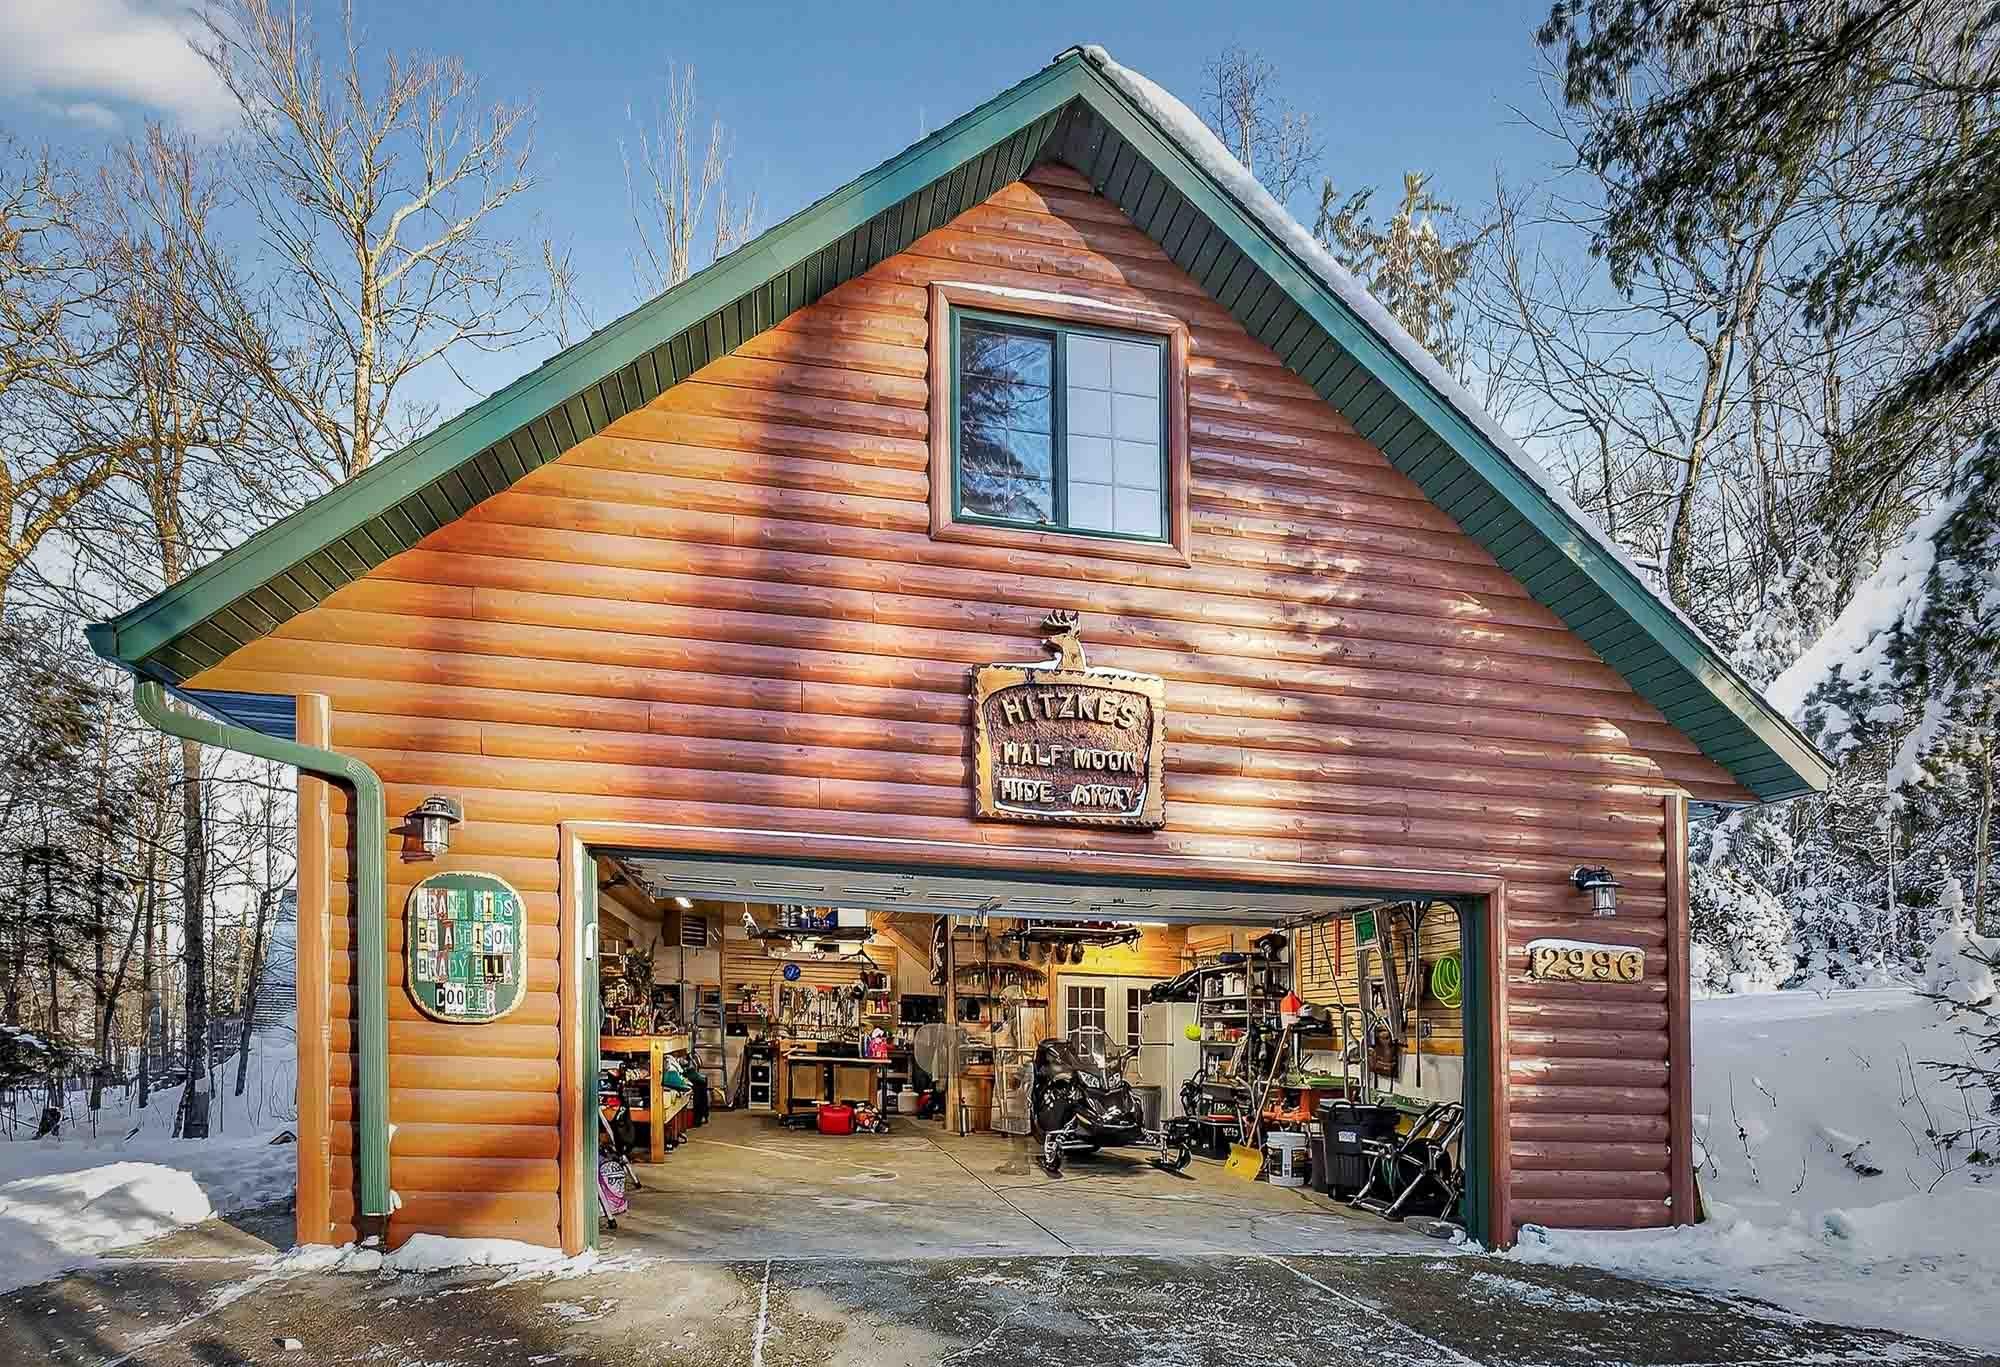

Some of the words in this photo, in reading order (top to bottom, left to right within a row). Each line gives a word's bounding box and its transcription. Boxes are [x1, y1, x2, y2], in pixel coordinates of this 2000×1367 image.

[1003, 741, 1063, 766] HALF
[1073, 748, 1138, 772] MOON
[1000, 779, 1055, 804] HIDE
[1070, 784, 1137, 809] AWAY
[417, 893, 467, 916] RAN
[1541, 947, 1637, 980] 2996
[436, 987, 496, 1012] COOPER
